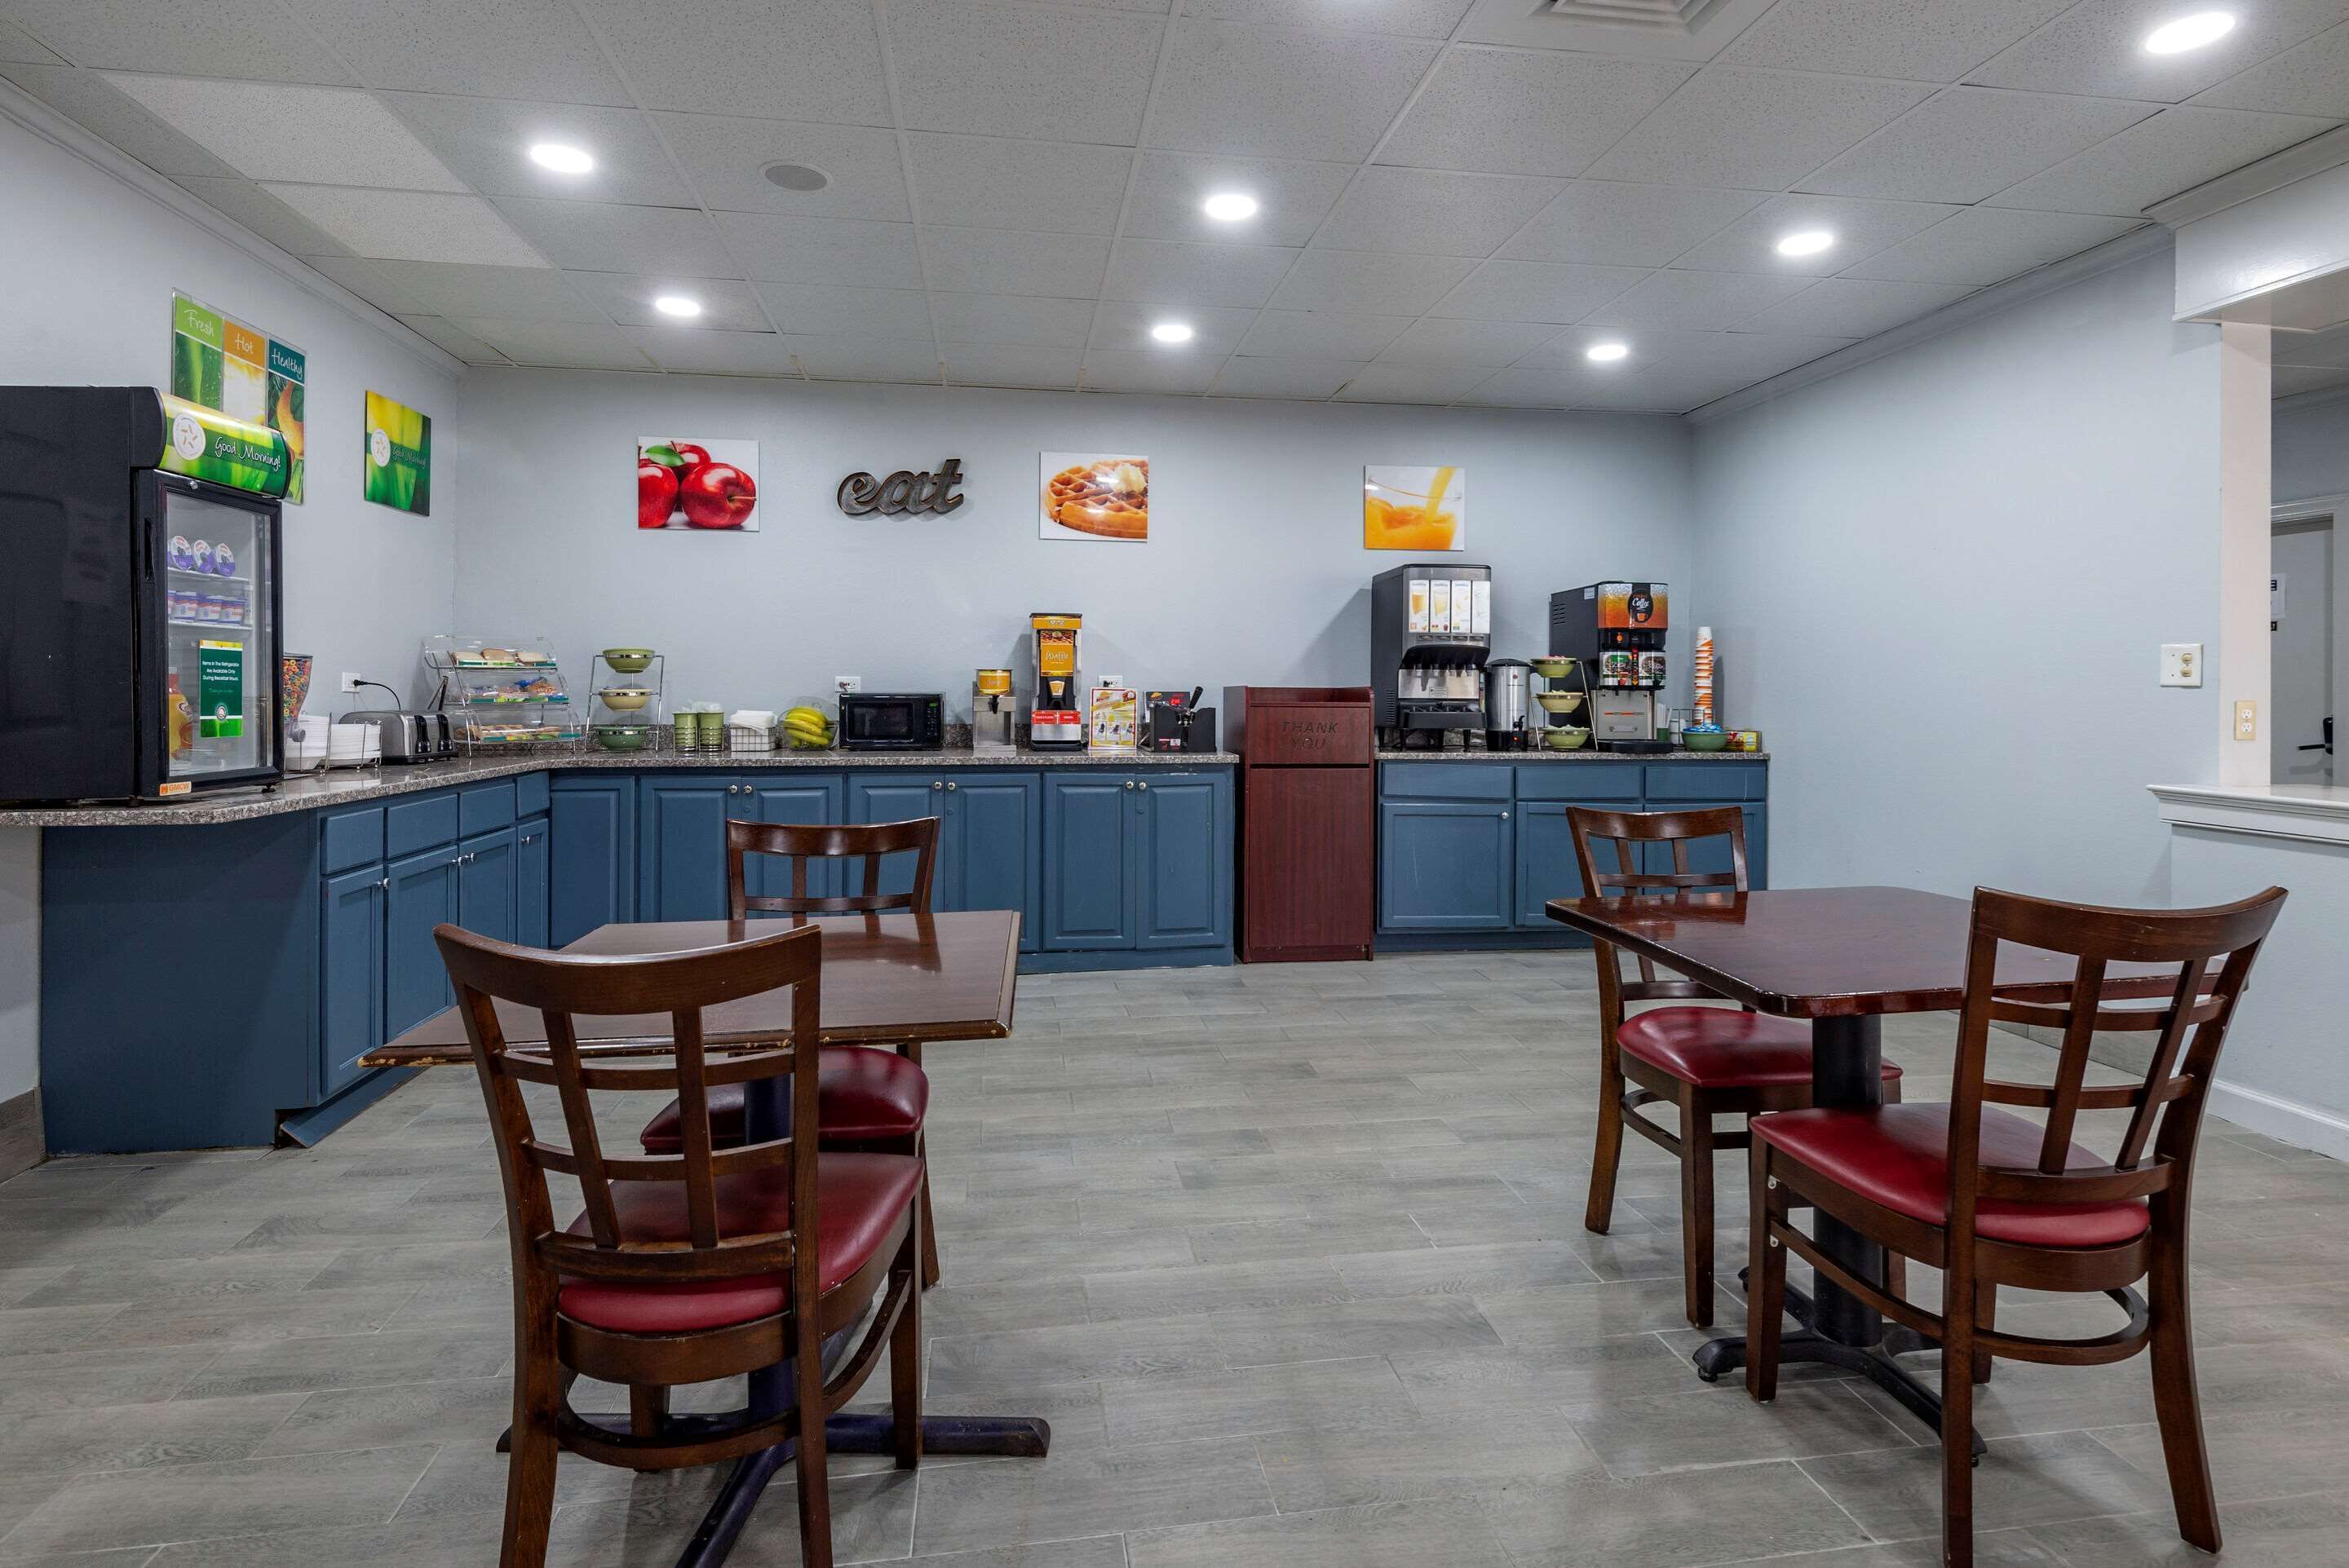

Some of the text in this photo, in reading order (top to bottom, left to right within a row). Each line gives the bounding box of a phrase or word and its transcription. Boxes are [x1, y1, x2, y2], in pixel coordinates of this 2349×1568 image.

[184, 309, 215, 336] Fresh
[235, 333, 254, 354] Hot
[271, 349, 303, 380] Healthy
[215, 436, 281, 472] Good Morning!
[837, 458, 964, 515] eat
[1632, 597, 1649, 609] Coffee
[1281, 722, 1338, 734] THANK
[1291, 737, 1326, 750] YOU
